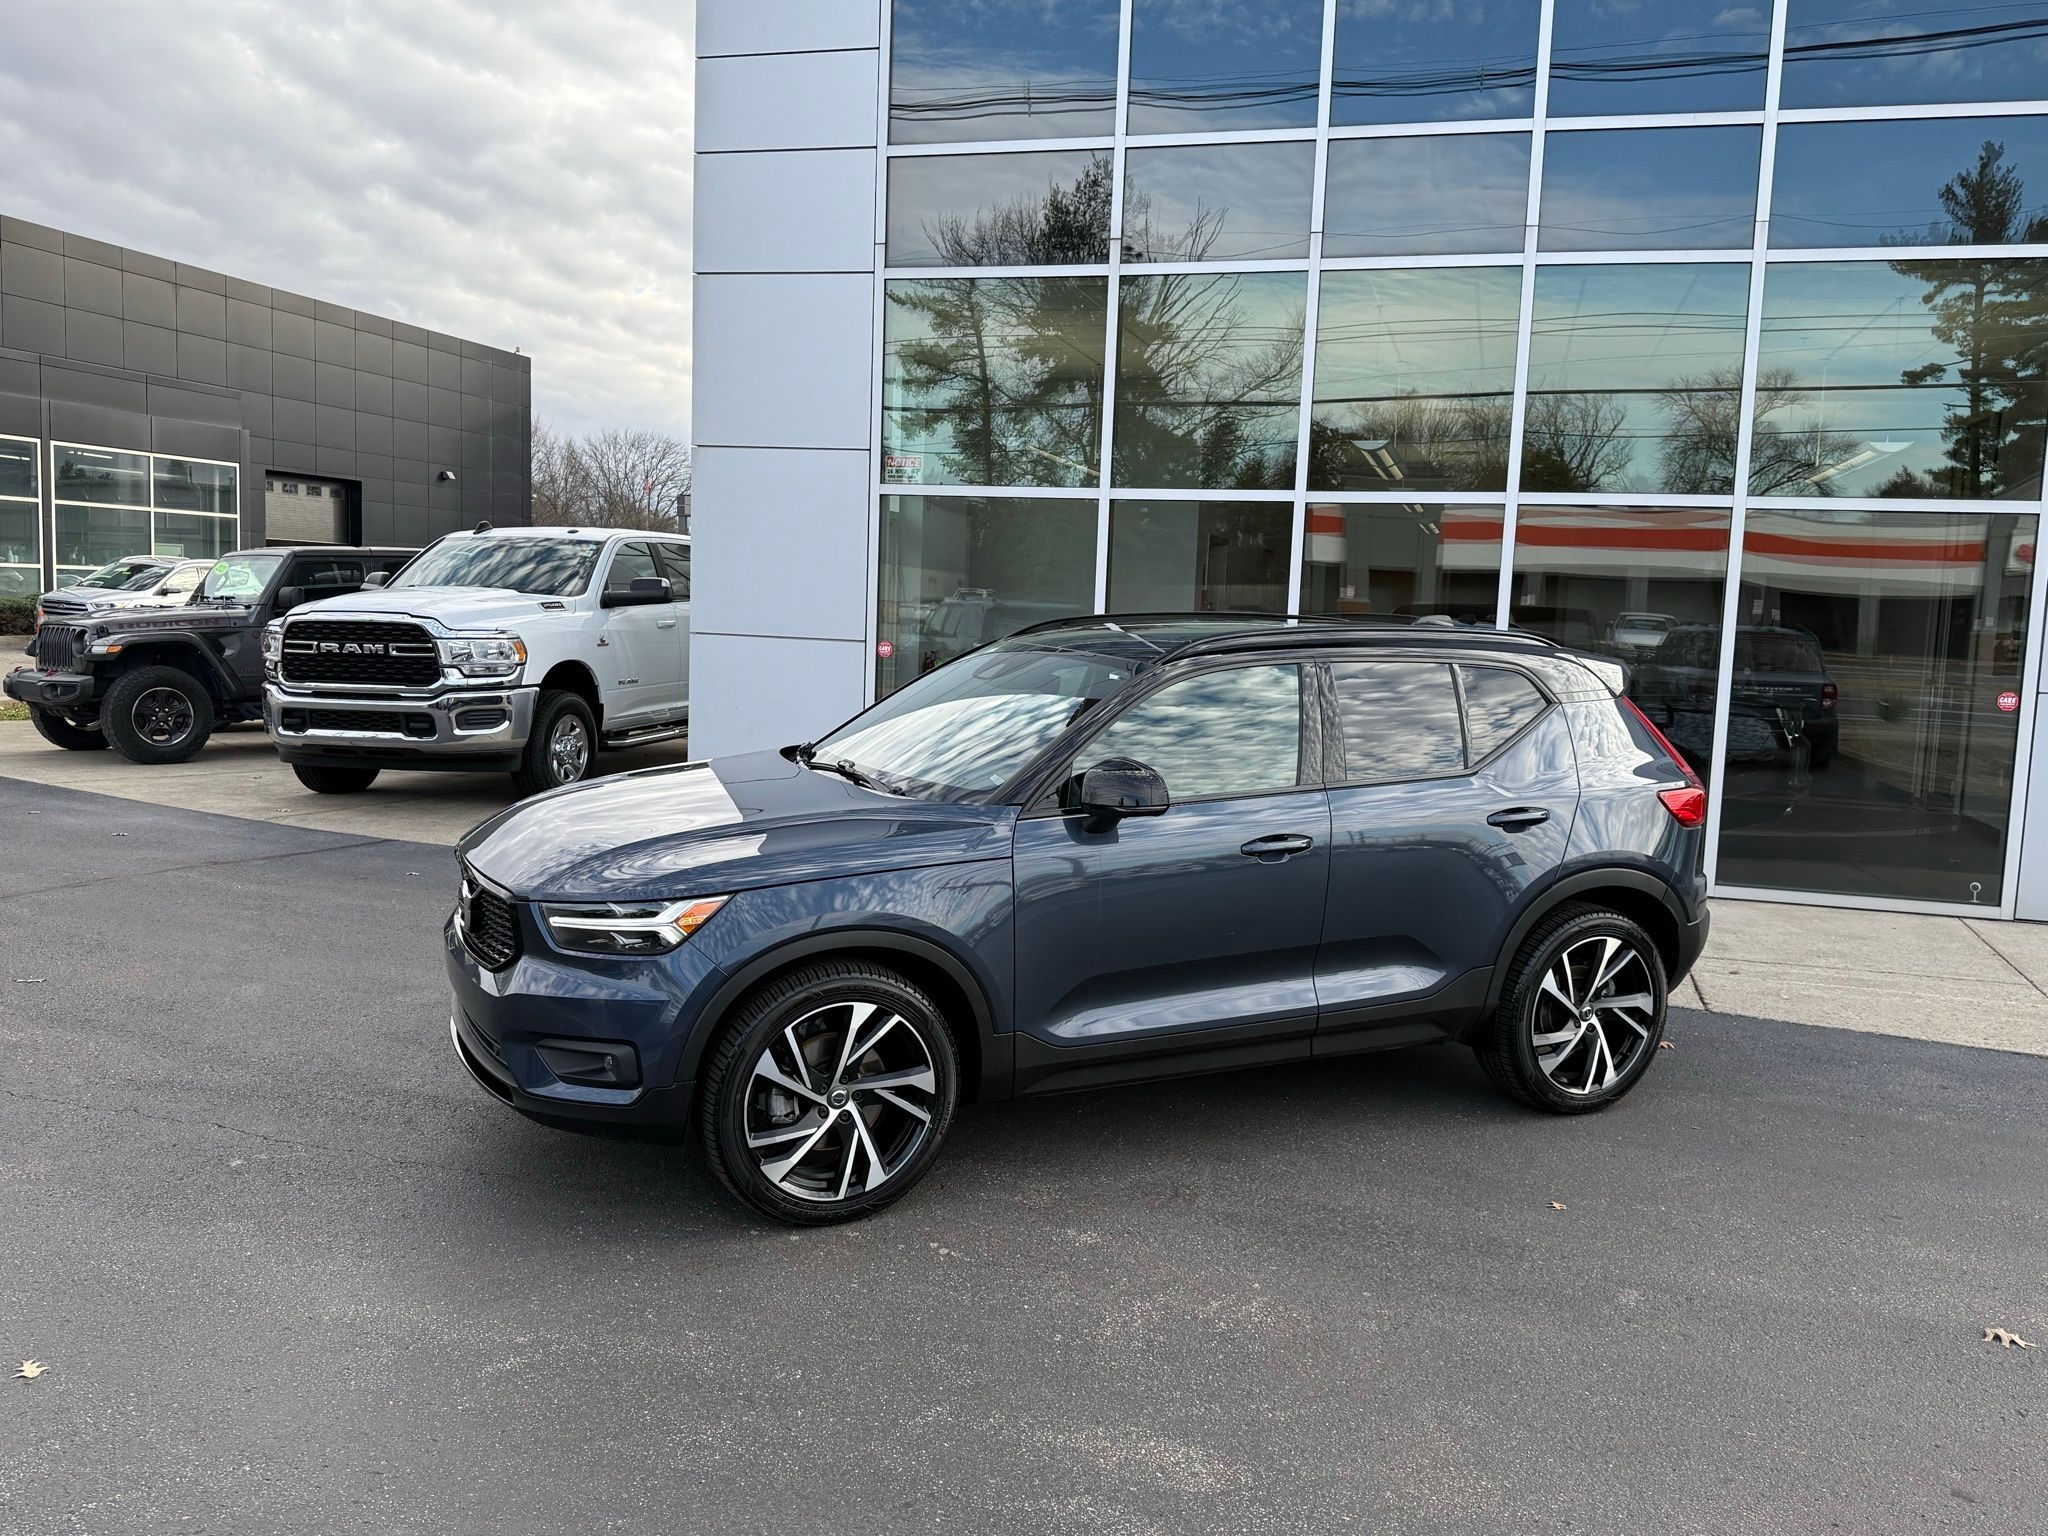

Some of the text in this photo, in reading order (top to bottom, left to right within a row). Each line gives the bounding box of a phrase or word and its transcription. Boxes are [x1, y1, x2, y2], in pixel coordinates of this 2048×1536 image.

[888, 458, 921, 467] NOTICE
[118, 618, 221, 630] RUBICON
[320, 642, 384, 654] RAM
